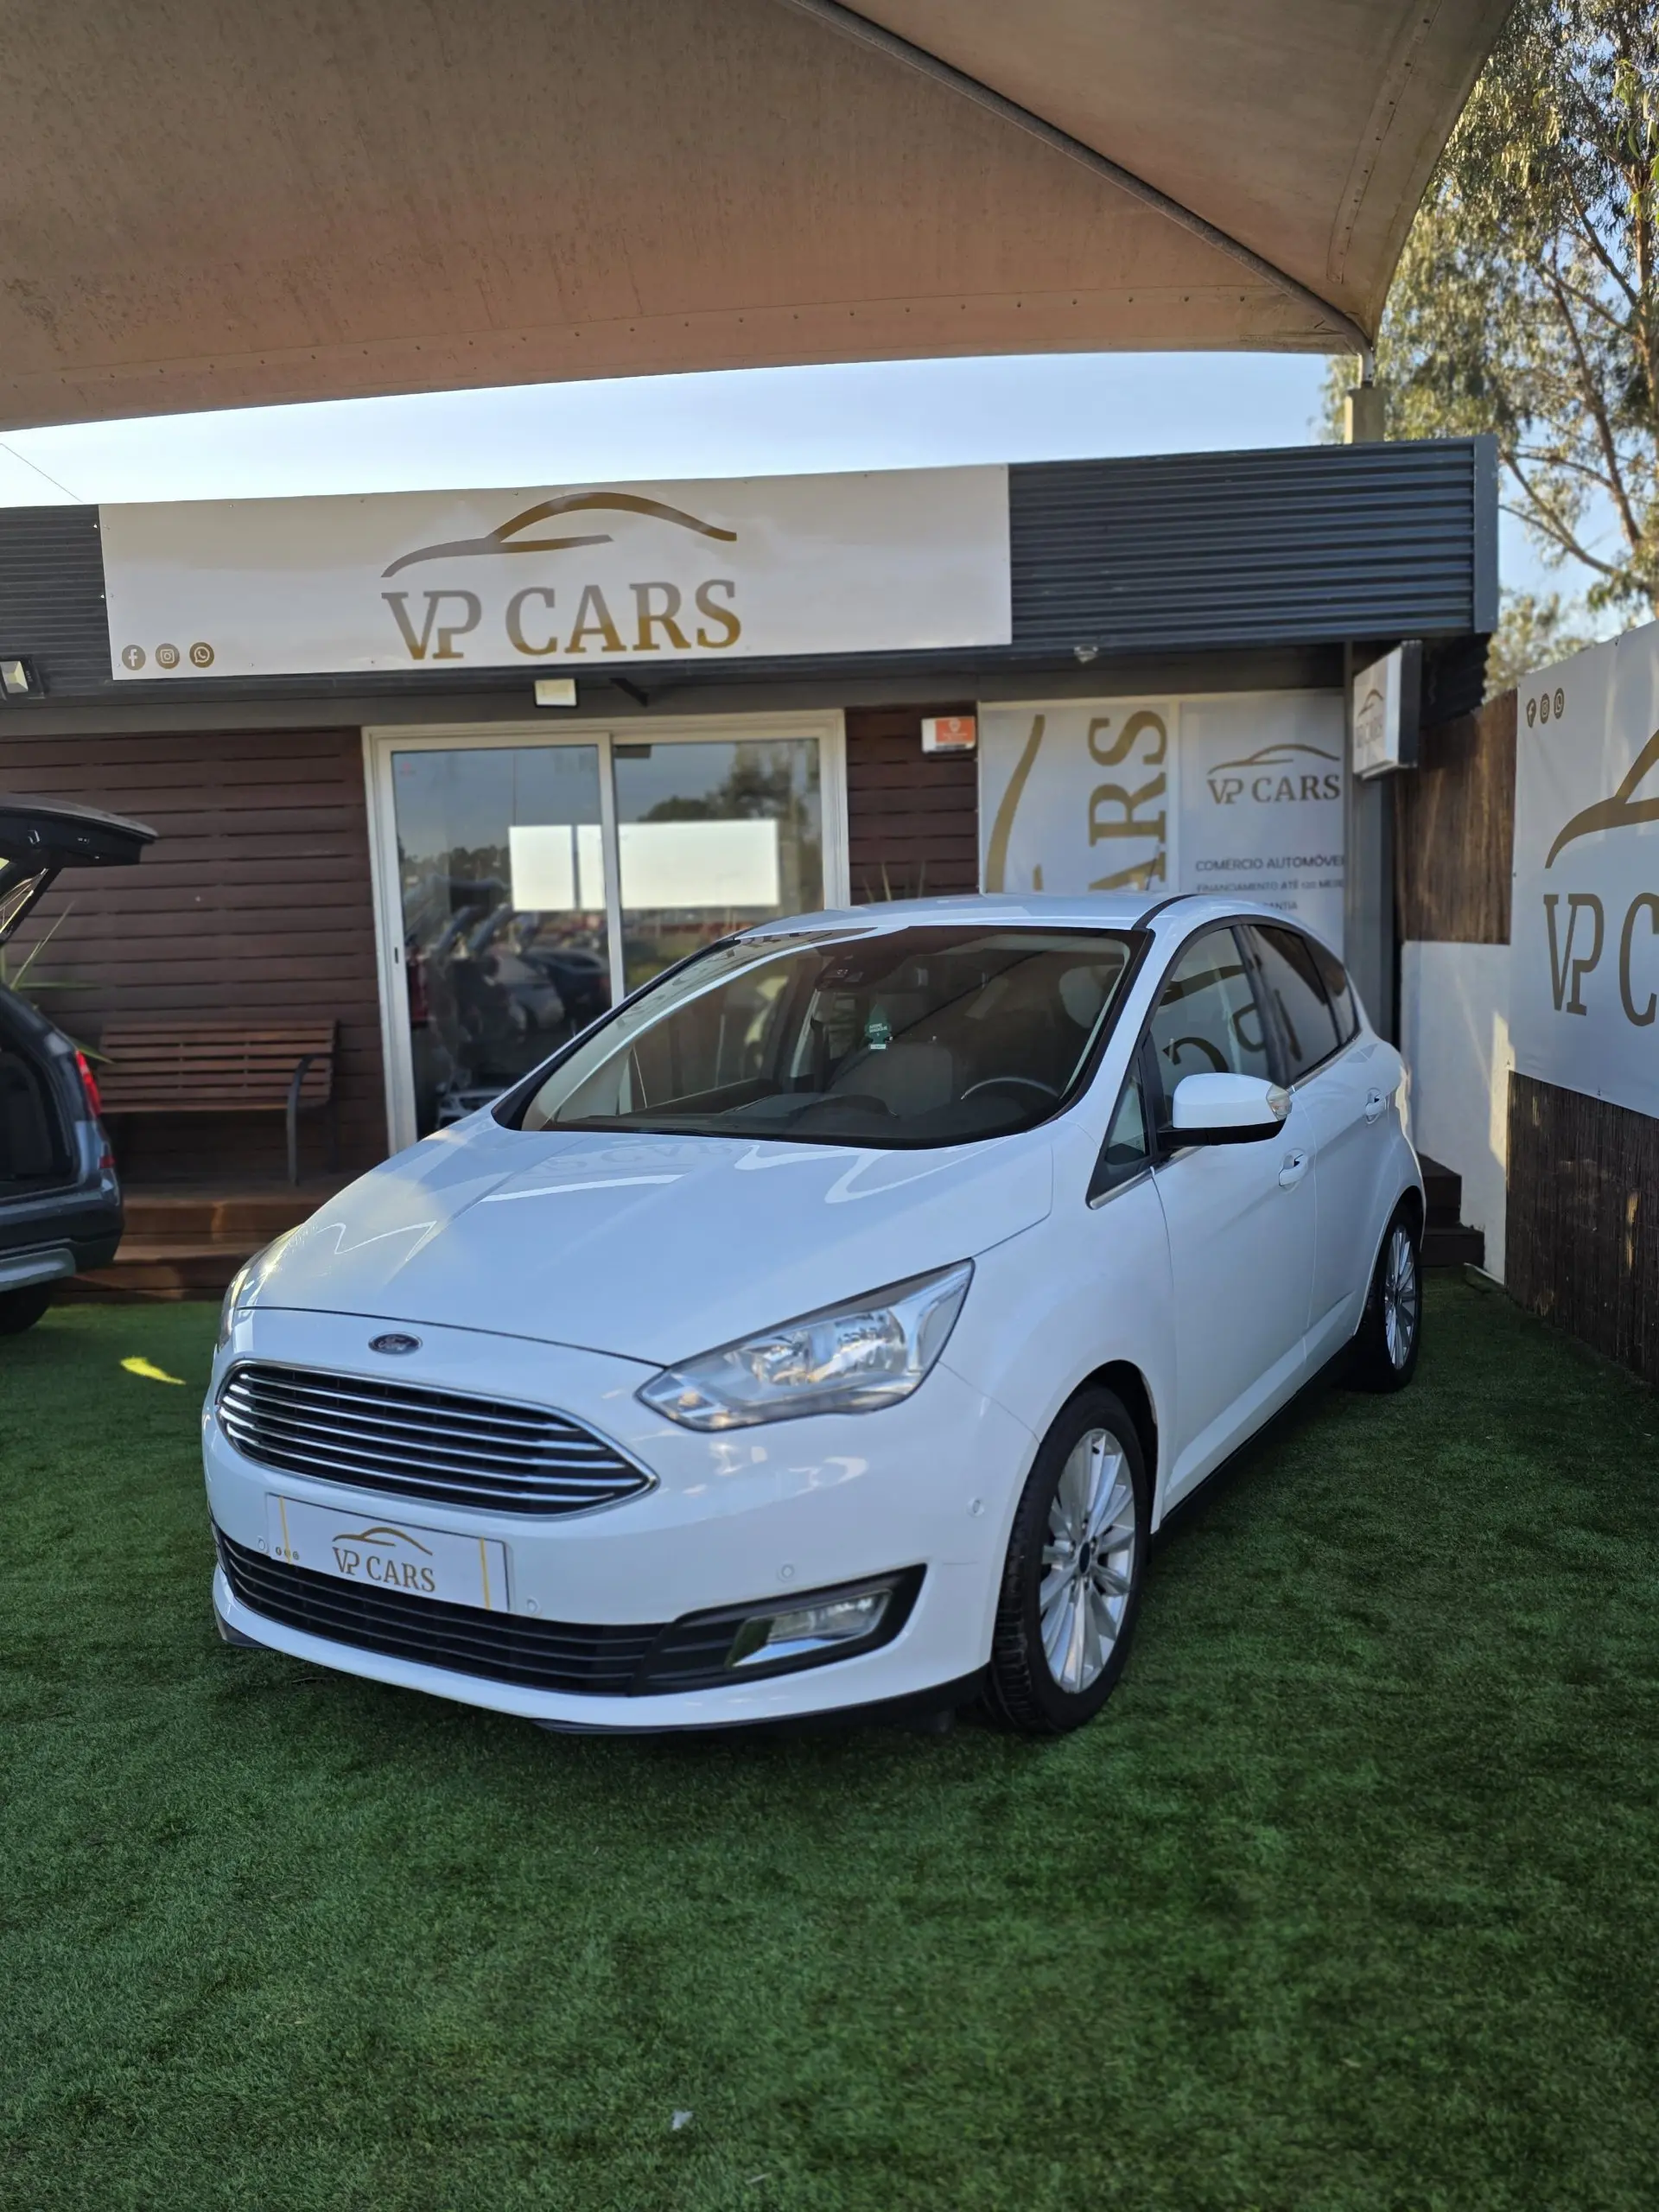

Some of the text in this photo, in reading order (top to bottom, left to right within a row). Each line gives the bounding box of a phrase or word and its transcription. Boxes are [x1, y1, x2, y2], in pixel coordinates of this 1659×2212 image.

[381, 579, 741, 660] VP CARS
[1207, 773, 1341, 804] VP CARS
[1543, 893, 1605, 1016] VP
[332, 1546, 435, 1592] VP CARS
